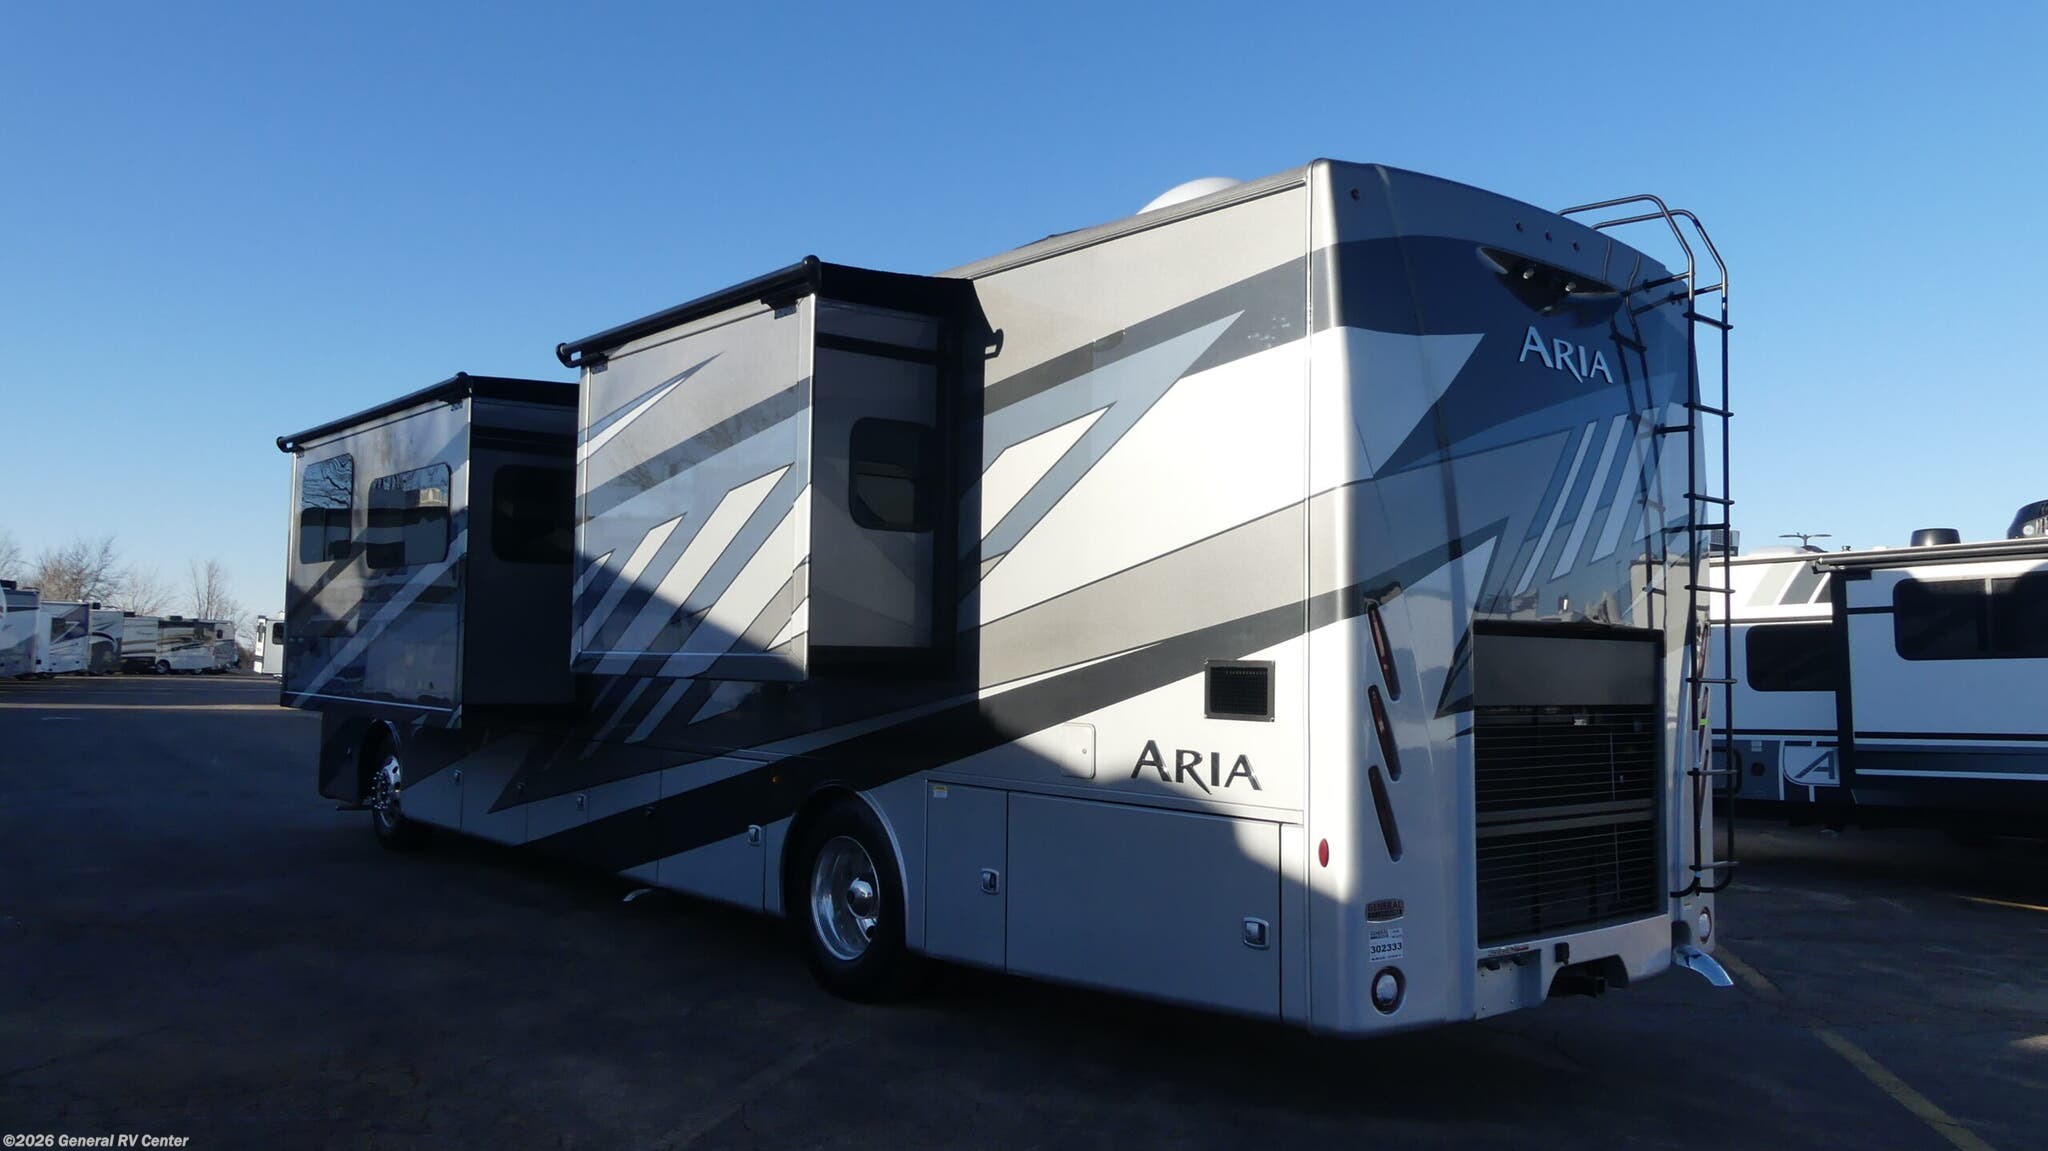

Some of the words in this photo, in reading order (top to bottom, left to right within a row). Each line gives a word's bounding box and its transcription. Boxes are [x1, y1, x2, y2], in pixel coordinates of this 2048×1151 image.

[1519, 325, 1614, 384] ARIA
[1130, 739, 1263, 796] ARIA
[1370, 942, 1402, 953] 302333
